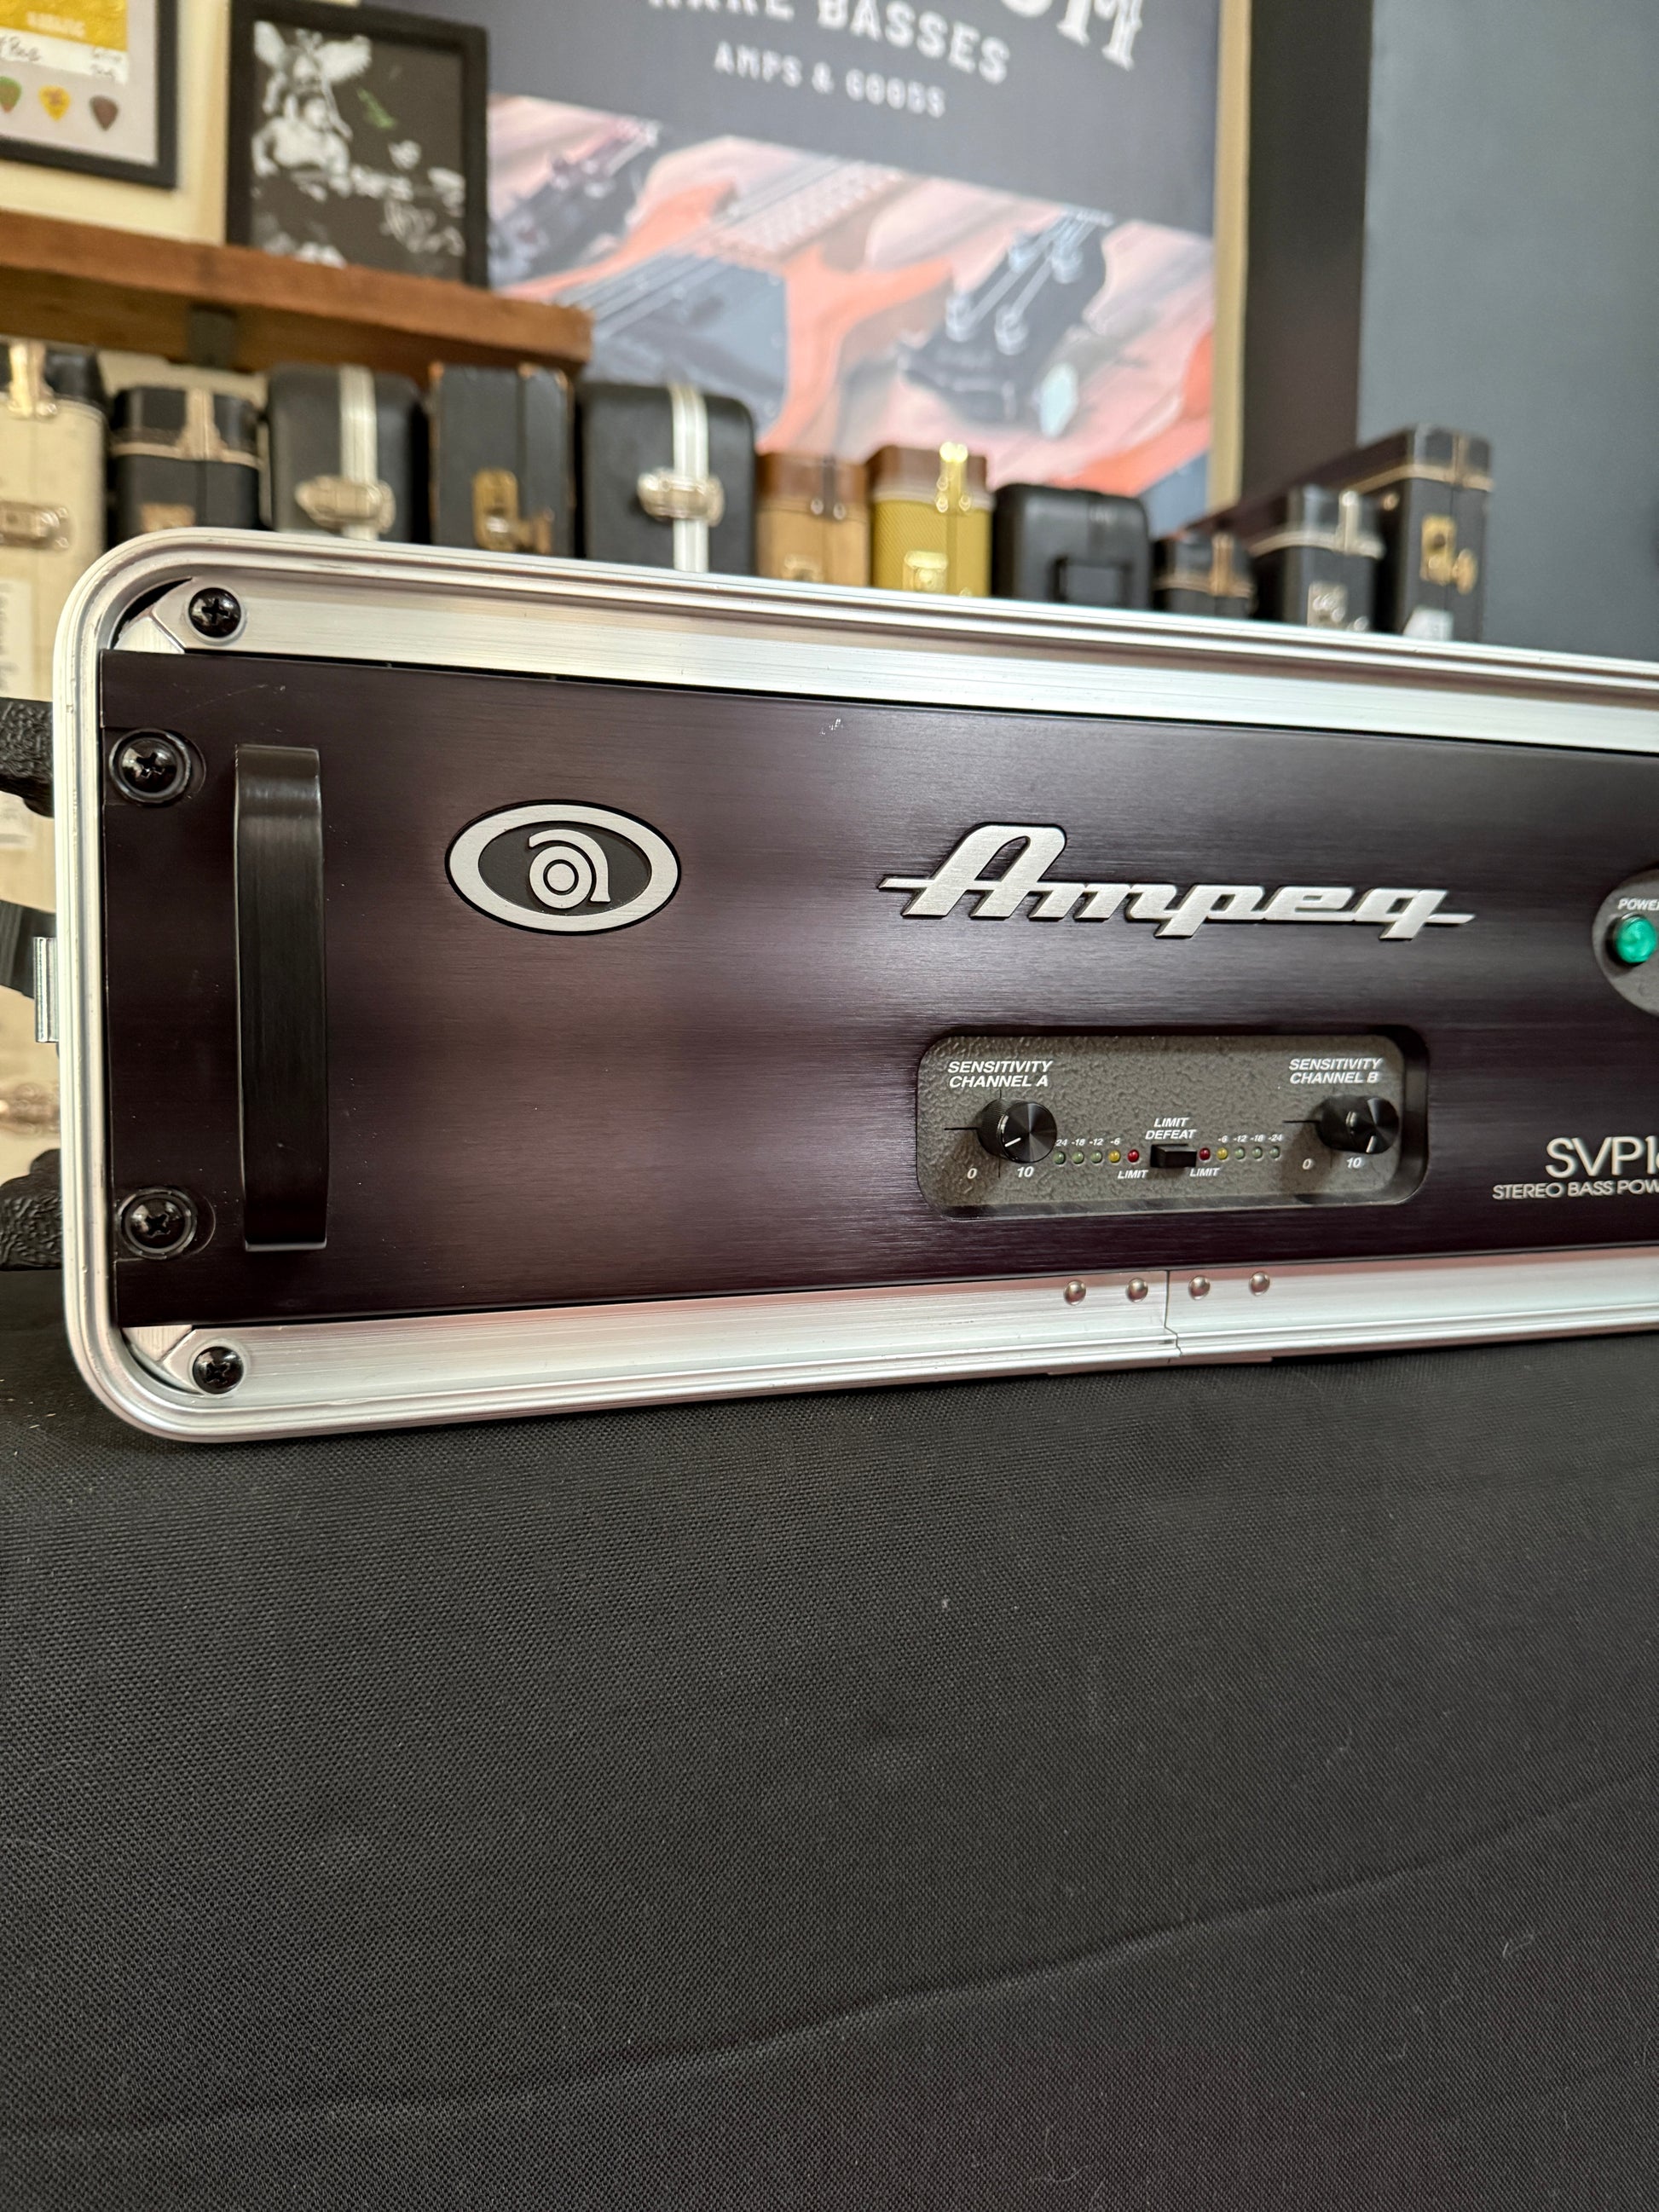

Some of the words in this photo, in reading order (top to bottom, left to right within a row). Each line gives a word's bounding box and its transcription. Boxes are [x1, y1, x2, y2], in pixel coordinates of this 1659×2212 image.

[817, 0, 1011, 84] BASSES
[714, 41, 803, 88] AMPS
[811, 61, 834, 95] &
[845, 67, 946, 118] GOODS
[878, 823, 1476, 940] Ampeg
[1617, 897, 1659, 911] POWE
[947, 1060, 1053, 1074] SENSITIVITY
[1288, 1057, 1383, 1071] SENSITIVITY
[949, 1074, 1032, 1089] CHANNEL
[1036, 1075, 1049, 1088] A
[1289, 1071, 1363, 1085] CHANNEL
[1366, 1071, 1380, 1084] B
[1153, 1117, 1189, 1128] LIMIT
[1071, 1138, 1086, 1146] -18
[1089, 1138, 1104, 1146] -12
[1110, 1137, 1121, 1146] -6
[1145, 1129, 1197, 1141] DEFEAT
[1346, 1157, 1362, 1169] 10
[1545, 1135, 1659, 1178] SVP1
[1017, 1166, 1035, 1178] 10
[1117, 1169, 1149, 1180] LIMIT
[1189, 1167, 1220, 1178] LIMIT
[1492, 1182, 1565, 1200] STEREO
[1567, 1180, 1615, 1197] BASS
